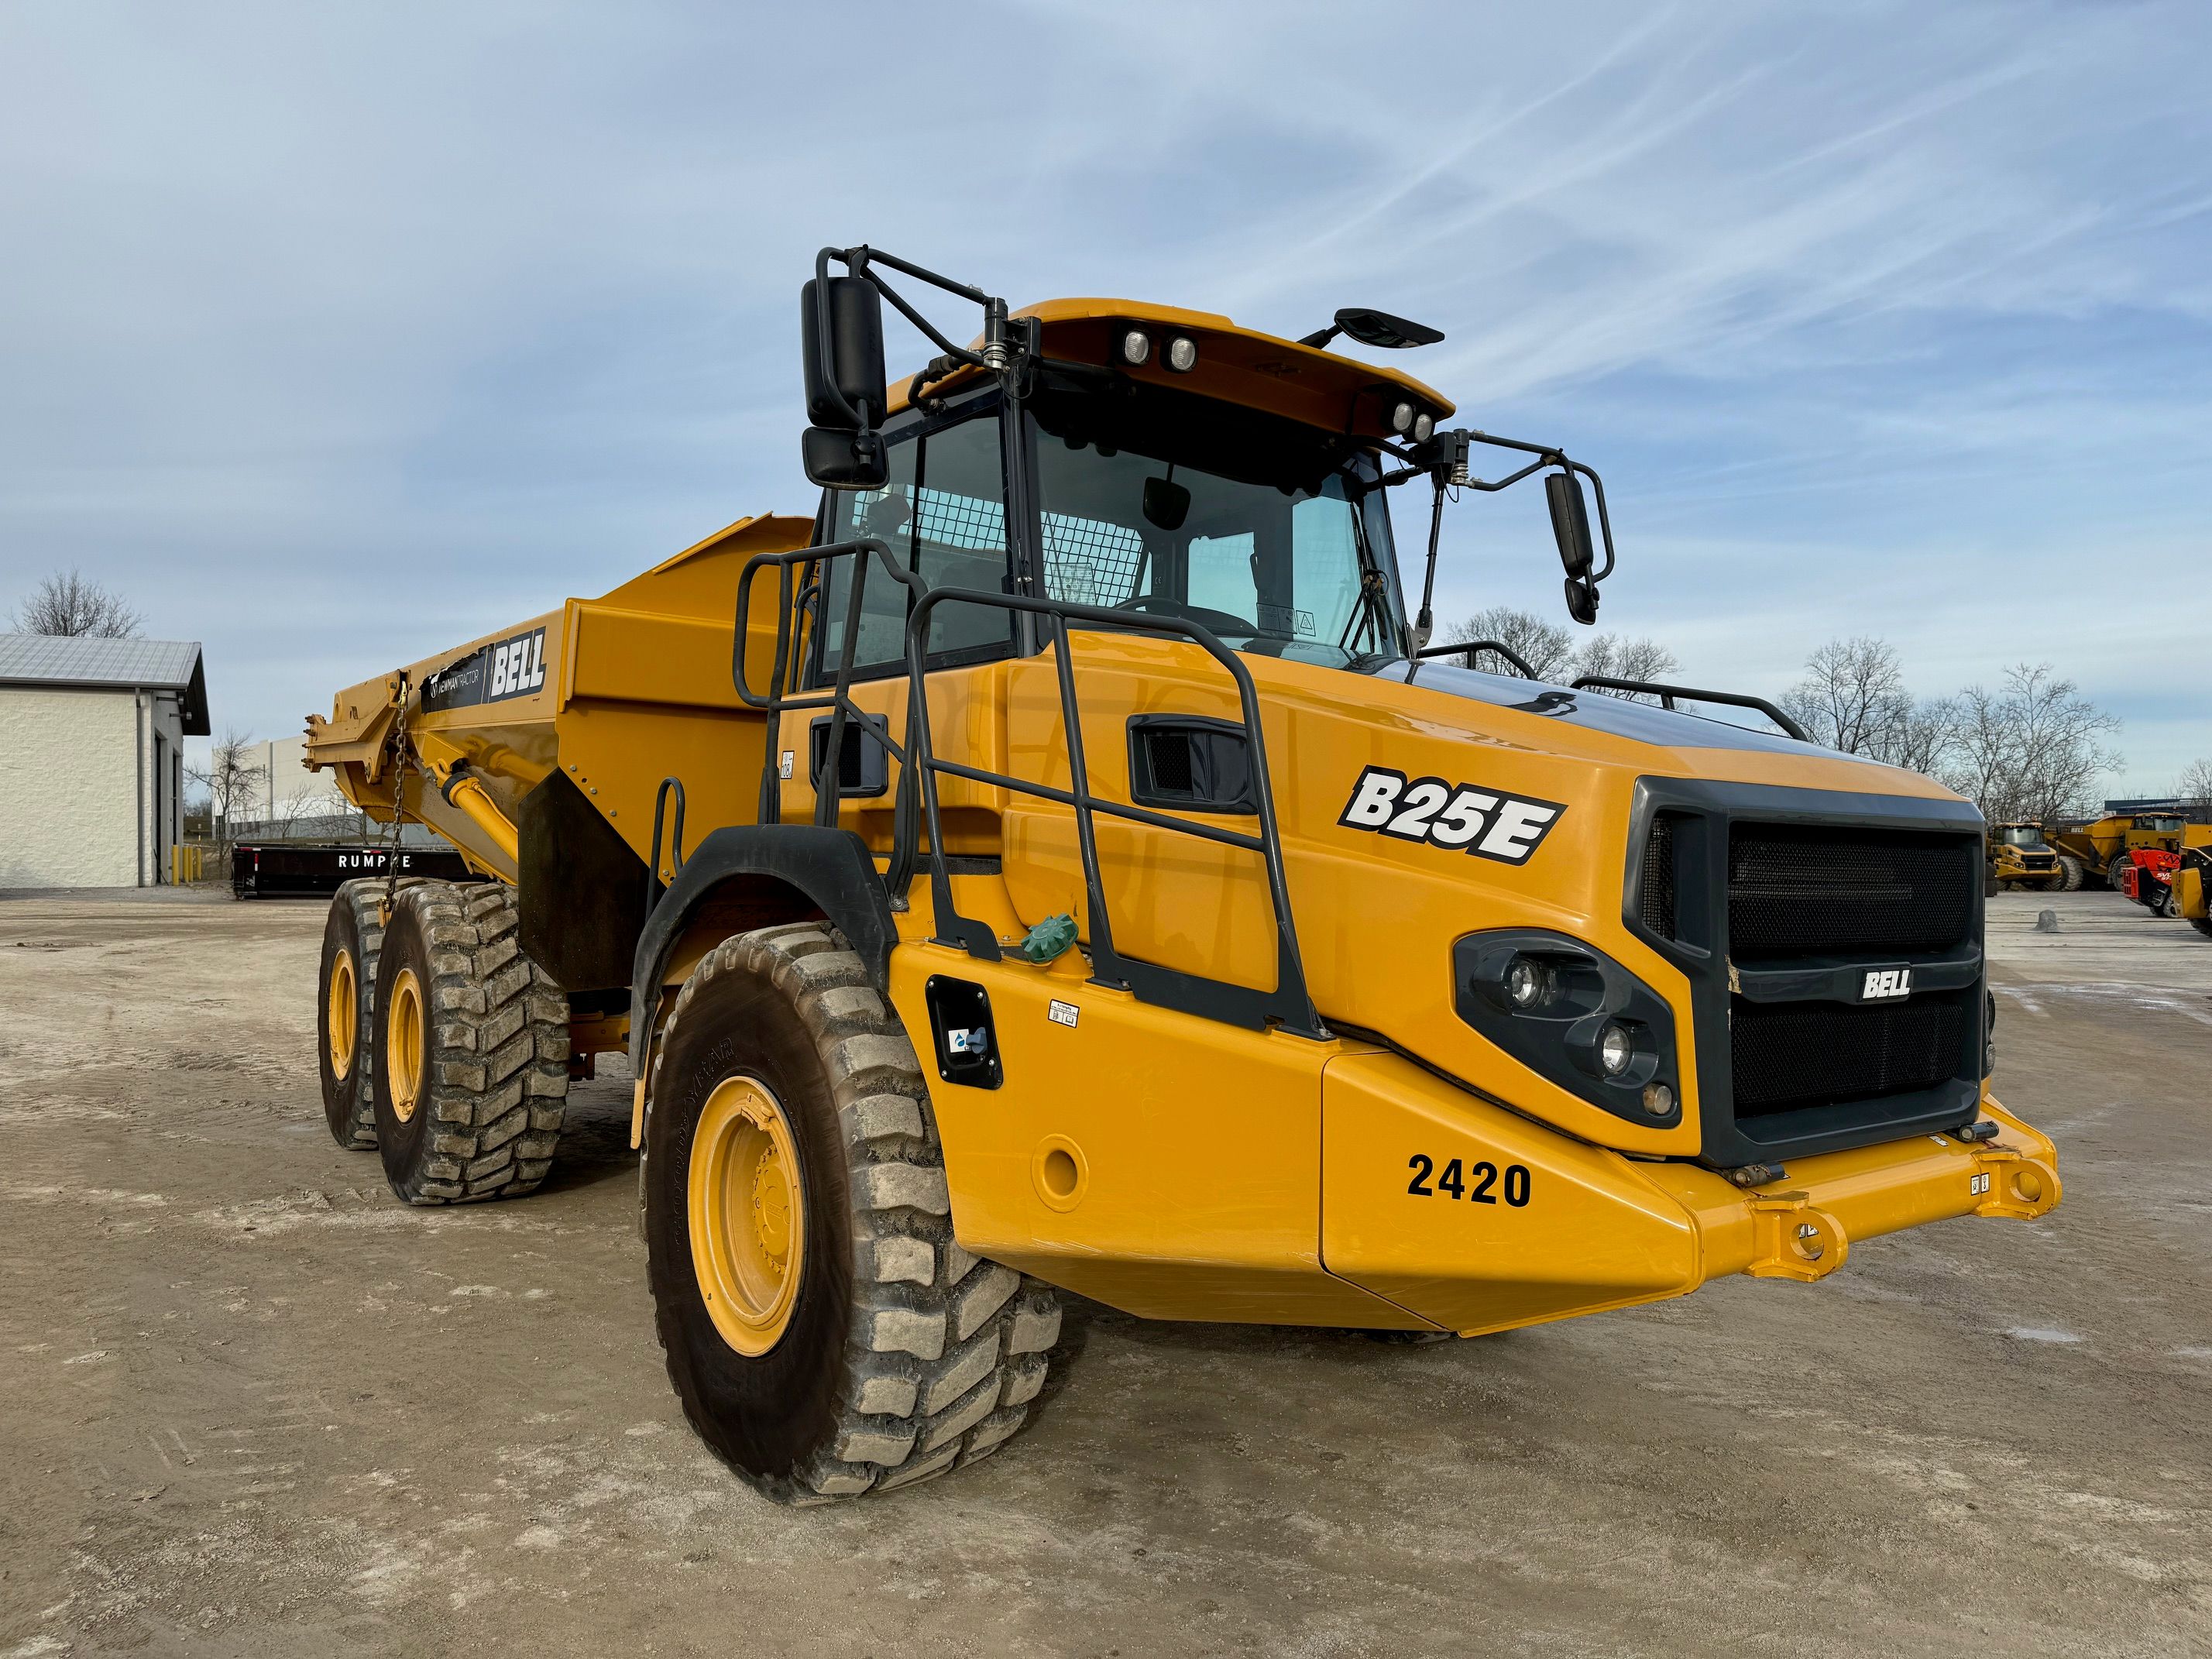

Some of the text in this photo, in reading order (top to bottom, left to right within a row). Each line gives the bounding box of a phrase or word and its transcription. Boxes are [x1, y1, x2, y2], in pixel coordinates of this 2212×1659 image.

[490, 634, 544, 697] BELL
[1345, 772, 1557, 858] B25E
[338, 855, 410, 867] RUMPE
[1862, 970, 1911, 998] BELL
[1407, 1153, 1531, 1207] 2420
